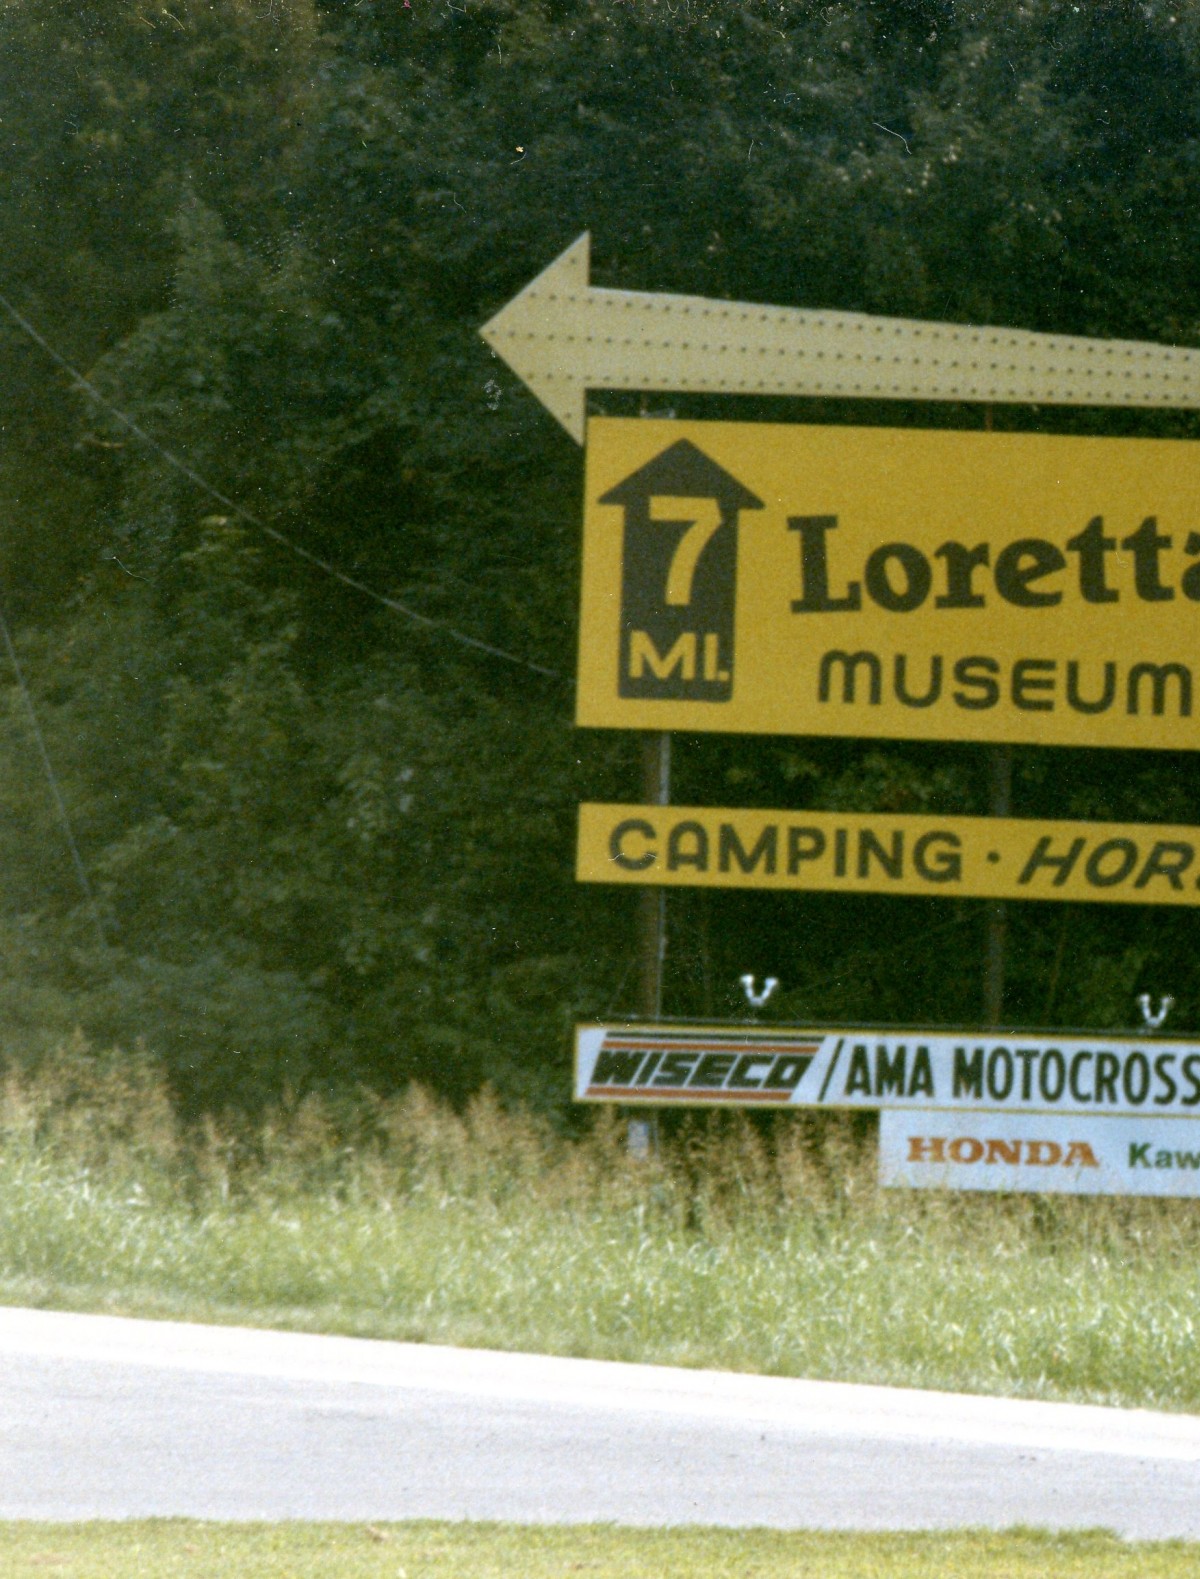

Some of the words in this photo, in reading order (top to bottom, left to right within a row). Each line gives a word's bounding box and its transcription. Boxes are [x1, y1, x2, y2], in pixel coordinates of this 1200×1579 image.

[648, 495, 723, 606] 7
[817, 648, 1194, 719] MUSEUM
[608, 817, 963, 884] CAMPING
[590, 1050, 814, 1090] WISECO
[906, 1136, 1100, 1168] HONDA
